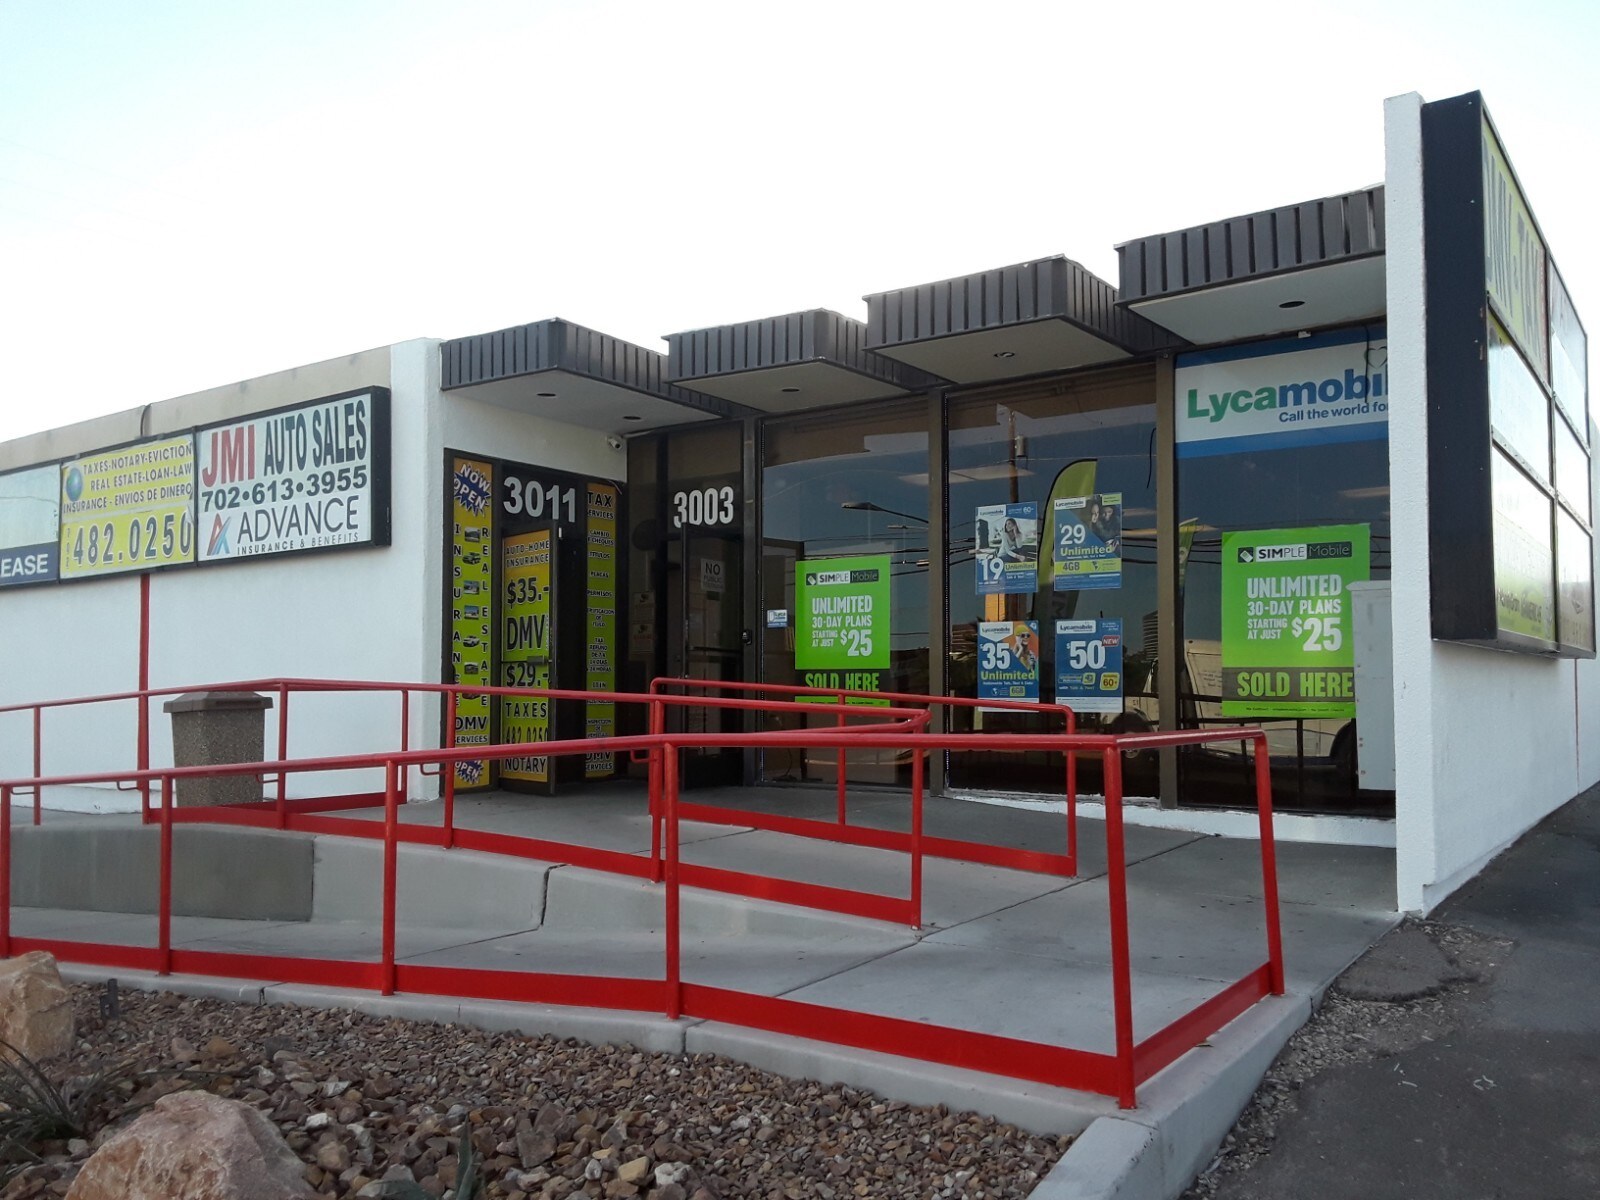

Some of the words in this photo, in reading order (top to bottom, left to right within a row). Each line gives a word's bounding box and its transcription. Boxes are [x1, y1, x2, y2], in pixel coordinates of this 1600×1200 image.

[1279, 410, 1304, 423] Call
[1307, 409, 1329, 420] the
[1331, 402, 1370, 418] world
[1372, 402, 1388, 413] fo
[202, 424, 256, 488] JMI
[264, 412, 307, 477] AUTO
[312, 399, 367, 468] SALES
[90, 477, 112, 492] REAL
[460, 463, 490, 491] NOW
[63, 494, 107, 515] INSURANCE
[114, 486, 145, 506] ENVIOS
[147, 486, 159, 502] DE
[161, 481, 192, 501] DINERO
[454, 477, 486, 510] OPEN
[503, 476, 576, 523] 3011
[588, 491, 612, 507] TAX
[588, 509, 614, 519] ERVICES
[673, 485, 734, 528] 3003
[237, 494, 360, 545] ADVANCE
[72, 511, 191, 568] 482.0250
[237, 541, 296, 556] INSURANCE
[311, 532, 359, 547] BENEFITS
[1060, 546, 1113, 556] Unlimited
[1258, 547, 1304, 559] SIMPLE
[1309, 545, 1350, 557] Mobile
[506, 553, 549, 567] INSURANCE
[705, 562, 720, 576] NO
[819, 573, 849, 583] SIMPLE
[852, 571, 878, 582] Mobile
[1247, 575, 1342, 599] UNLIMITED
[812, 595, 873, 615] UNLIMITED
[1248, 601, 1293, 616] 30-DAY
[1300, 599, 1341, 614] PLANS
[812, 616, 843, 628] 30-DAY
[845, 615, 872, 627] PLANS
[1248, 618, 1287, 629] STARTING
[507, 615, 545, 650] DMV
[812, 630, 838, 639] STARTING
[1248, 630, 1257, 640] AT
[1260, 629, 1281, 640] JUST
[1292, 616, 1342, 651] $25
[812, 639, 819, 647] AT
[820, 638, 834, 647] JUST
[840, 629, 872, 657] $25
[1102, 638, 1119, 646] NEW
[805, 672, 840, 689] SOLD
[845, 672, 880, 692] HERE
[981, 671, 1035, 681] Unlimited
[1237, 672, 1290, 697] SOLD
[1300, 672, 1353, 697] HERE
[506, 702, 547, 718] TAXES
[455, 716, 487, 730] DMV
[455, 734, 488, 743] ERVICES
[505, 757, 547, 772] NOTARY
